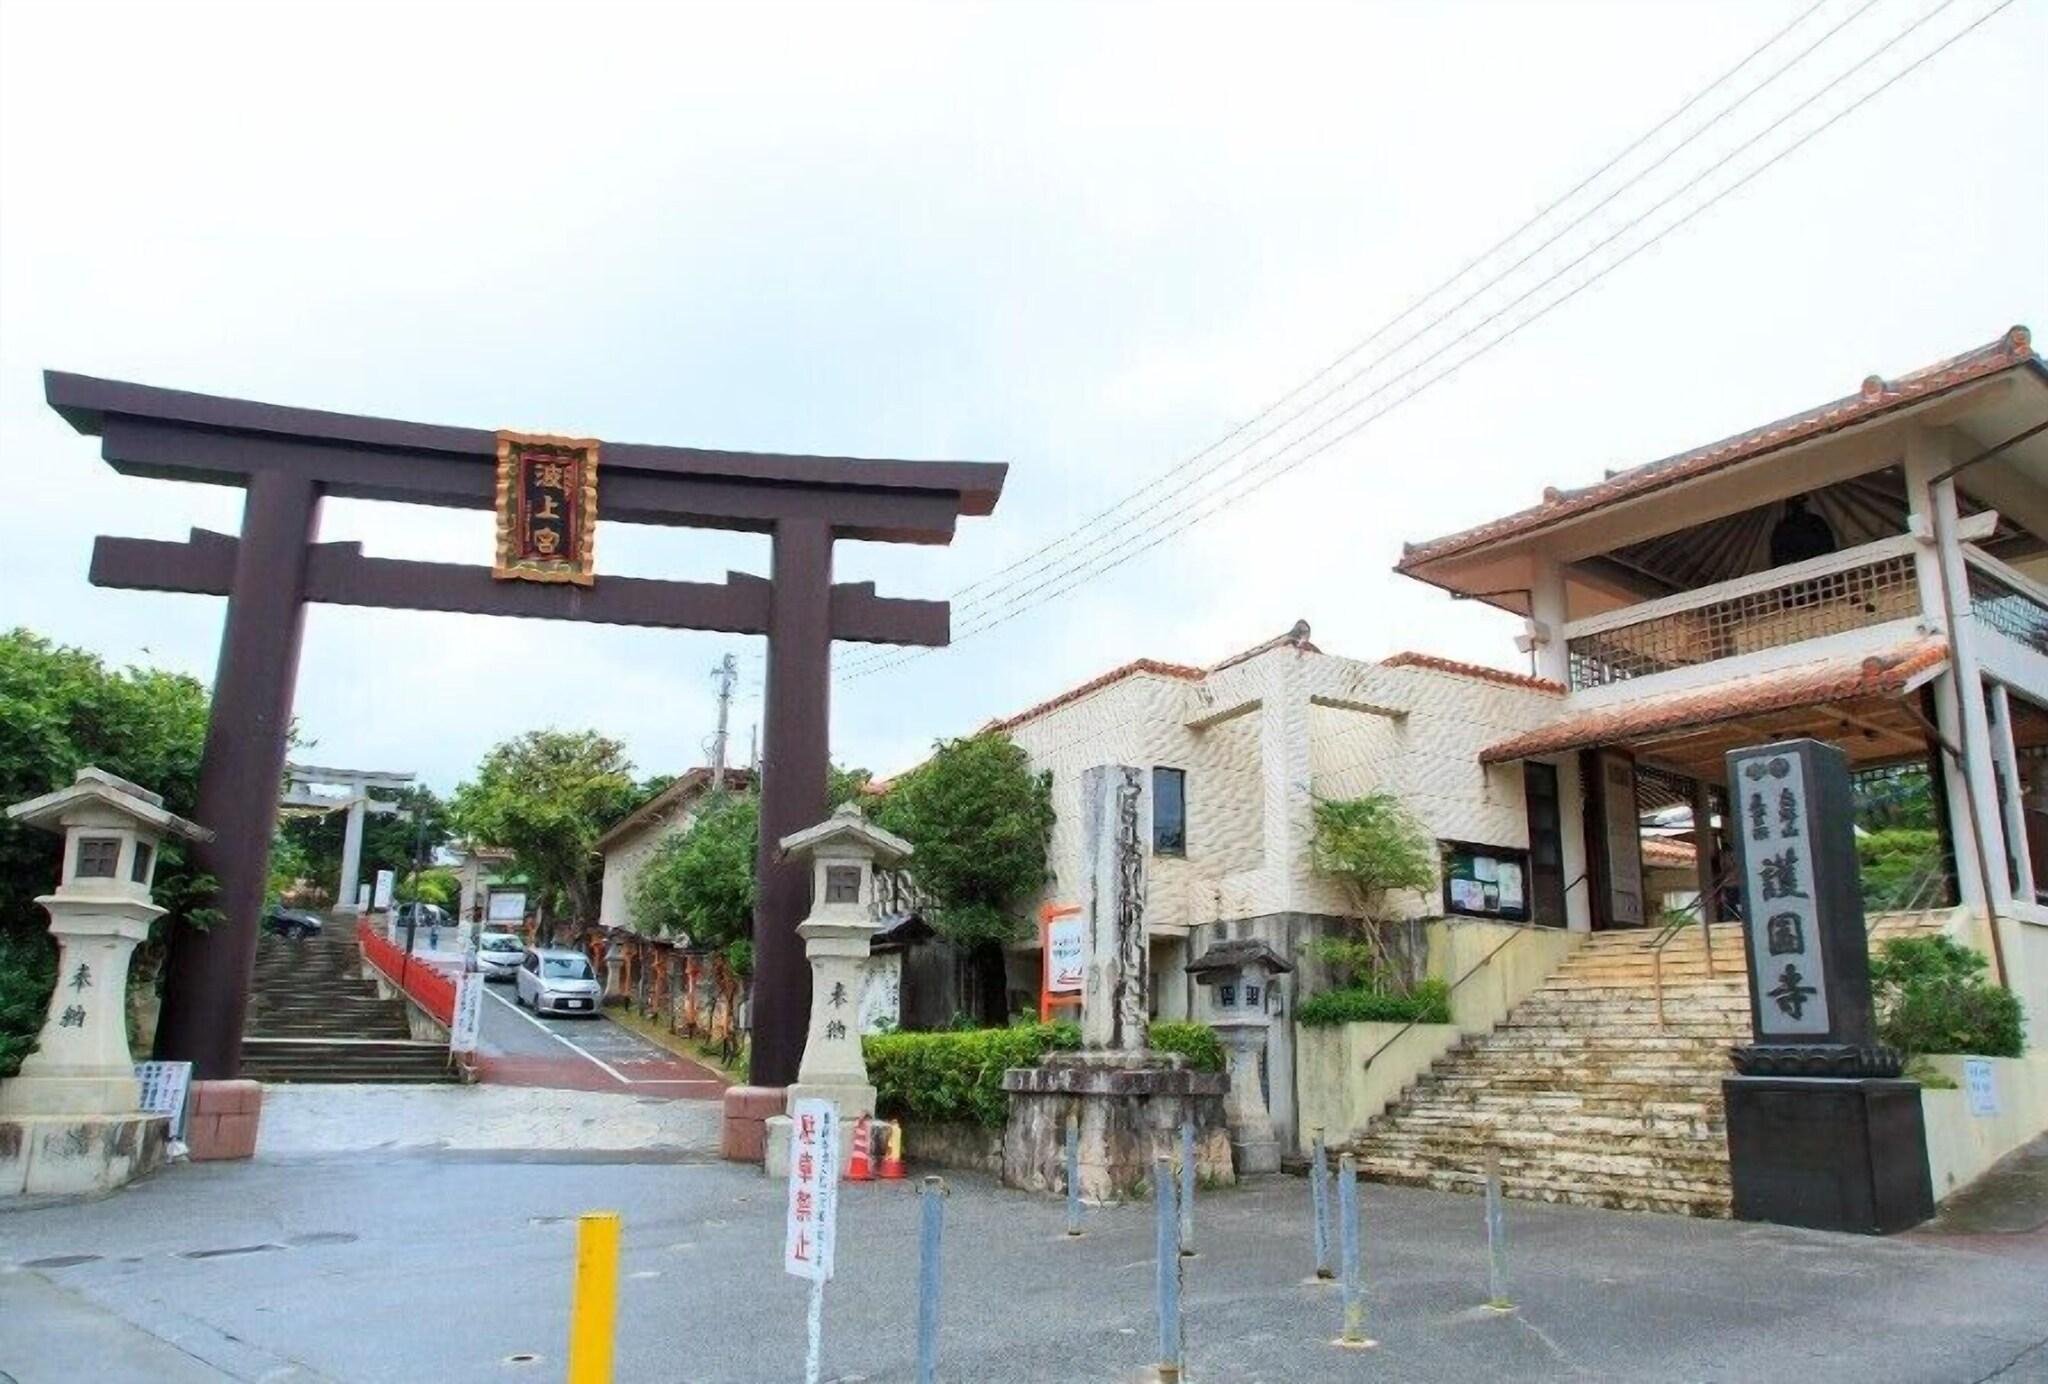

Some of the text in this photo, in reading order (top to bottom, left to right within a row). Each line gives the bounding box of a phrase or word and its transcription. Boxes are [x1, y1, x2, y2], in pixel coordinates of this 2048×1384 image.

[533, 463, 564, 554] 波上宮
[59, 963, 94, 1028] 奉納
[826, 981, 849, 1040] 奉納
[794, 1113, 816, 1261] 駐車禁止
